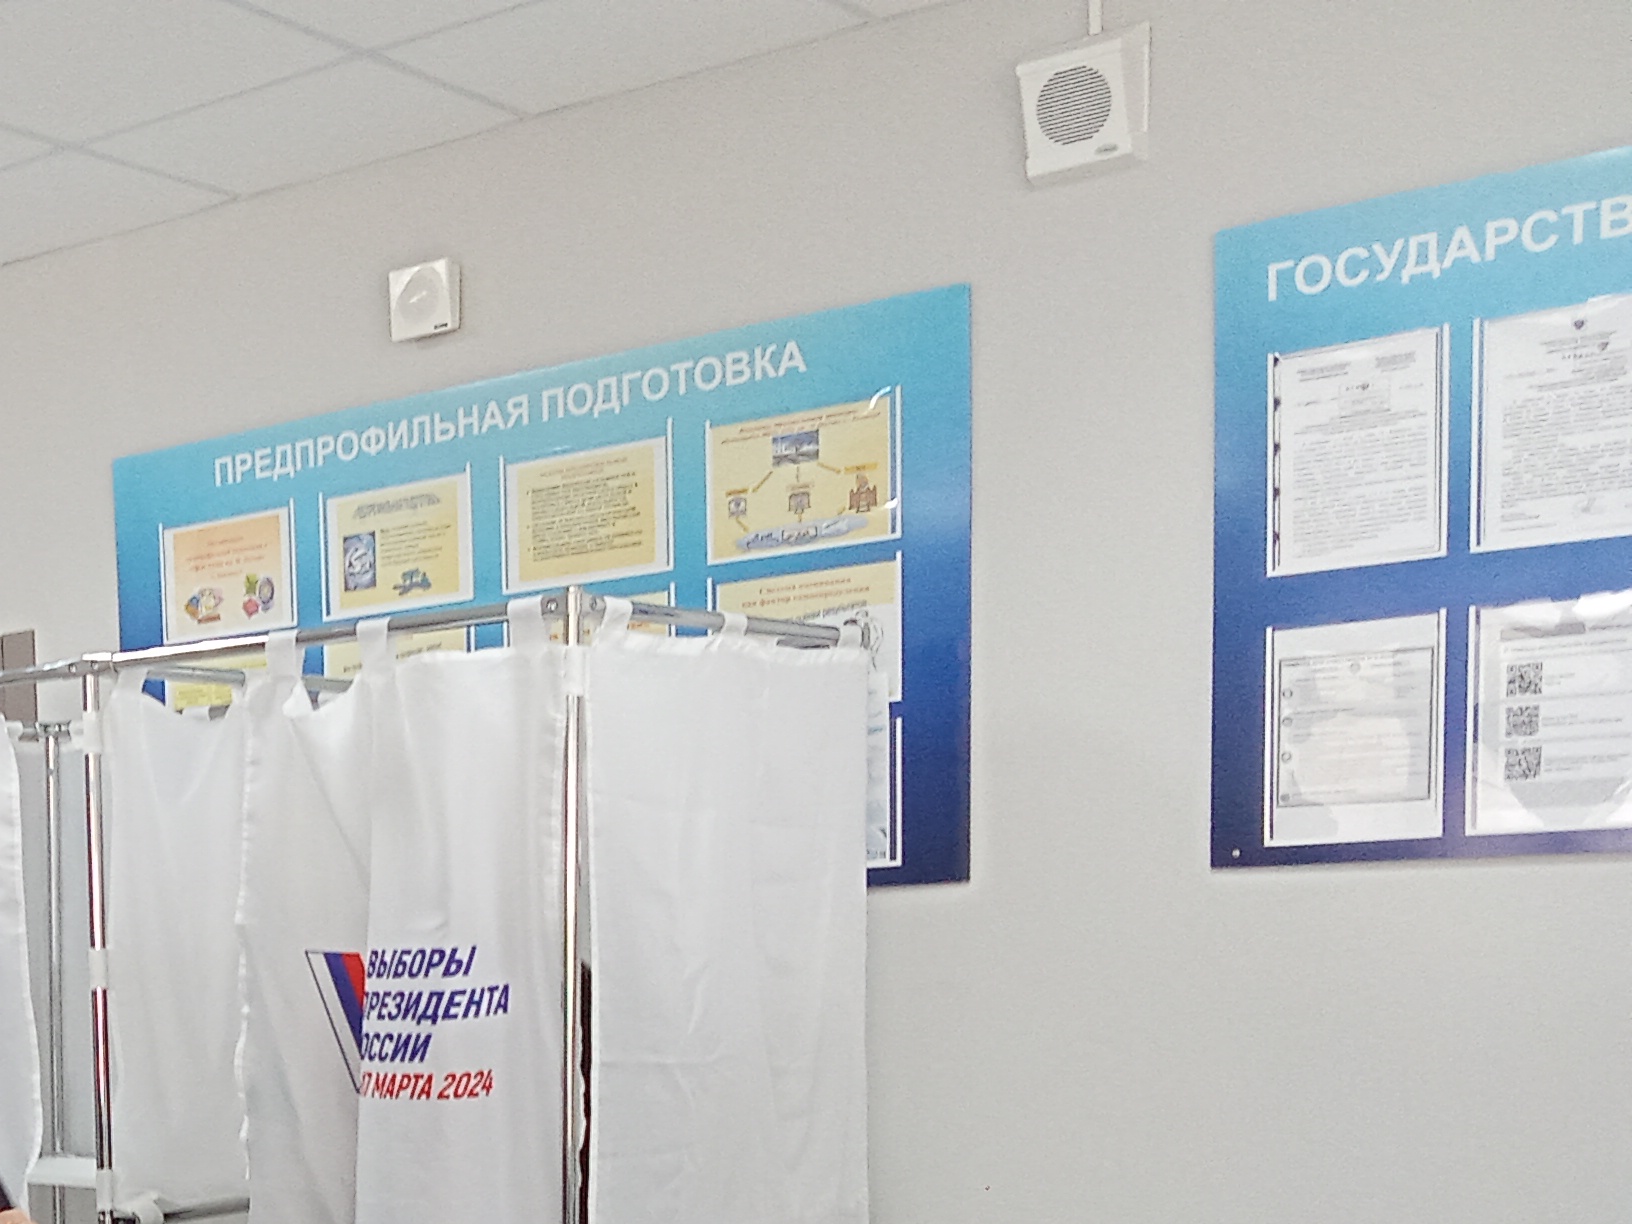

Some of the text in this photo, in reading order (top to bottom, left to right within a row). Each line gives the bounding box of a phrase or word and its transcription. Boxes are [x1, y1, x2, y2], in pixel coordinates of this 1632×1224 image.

[1266, 193, 1632, 302] ГОСУДАРСТВ
[212, 339, 808, 487] ПРЕДПРОФИЛЬНАЯ ПОДГОТОВКА
[367, 945, 478, 980] ВЫБОРЫ
[361, 1031, 433, 1063] ОССИИ
[371, 1071, 434, 1101] МАРТА
[437, 1068, 495, 1101] 2024
